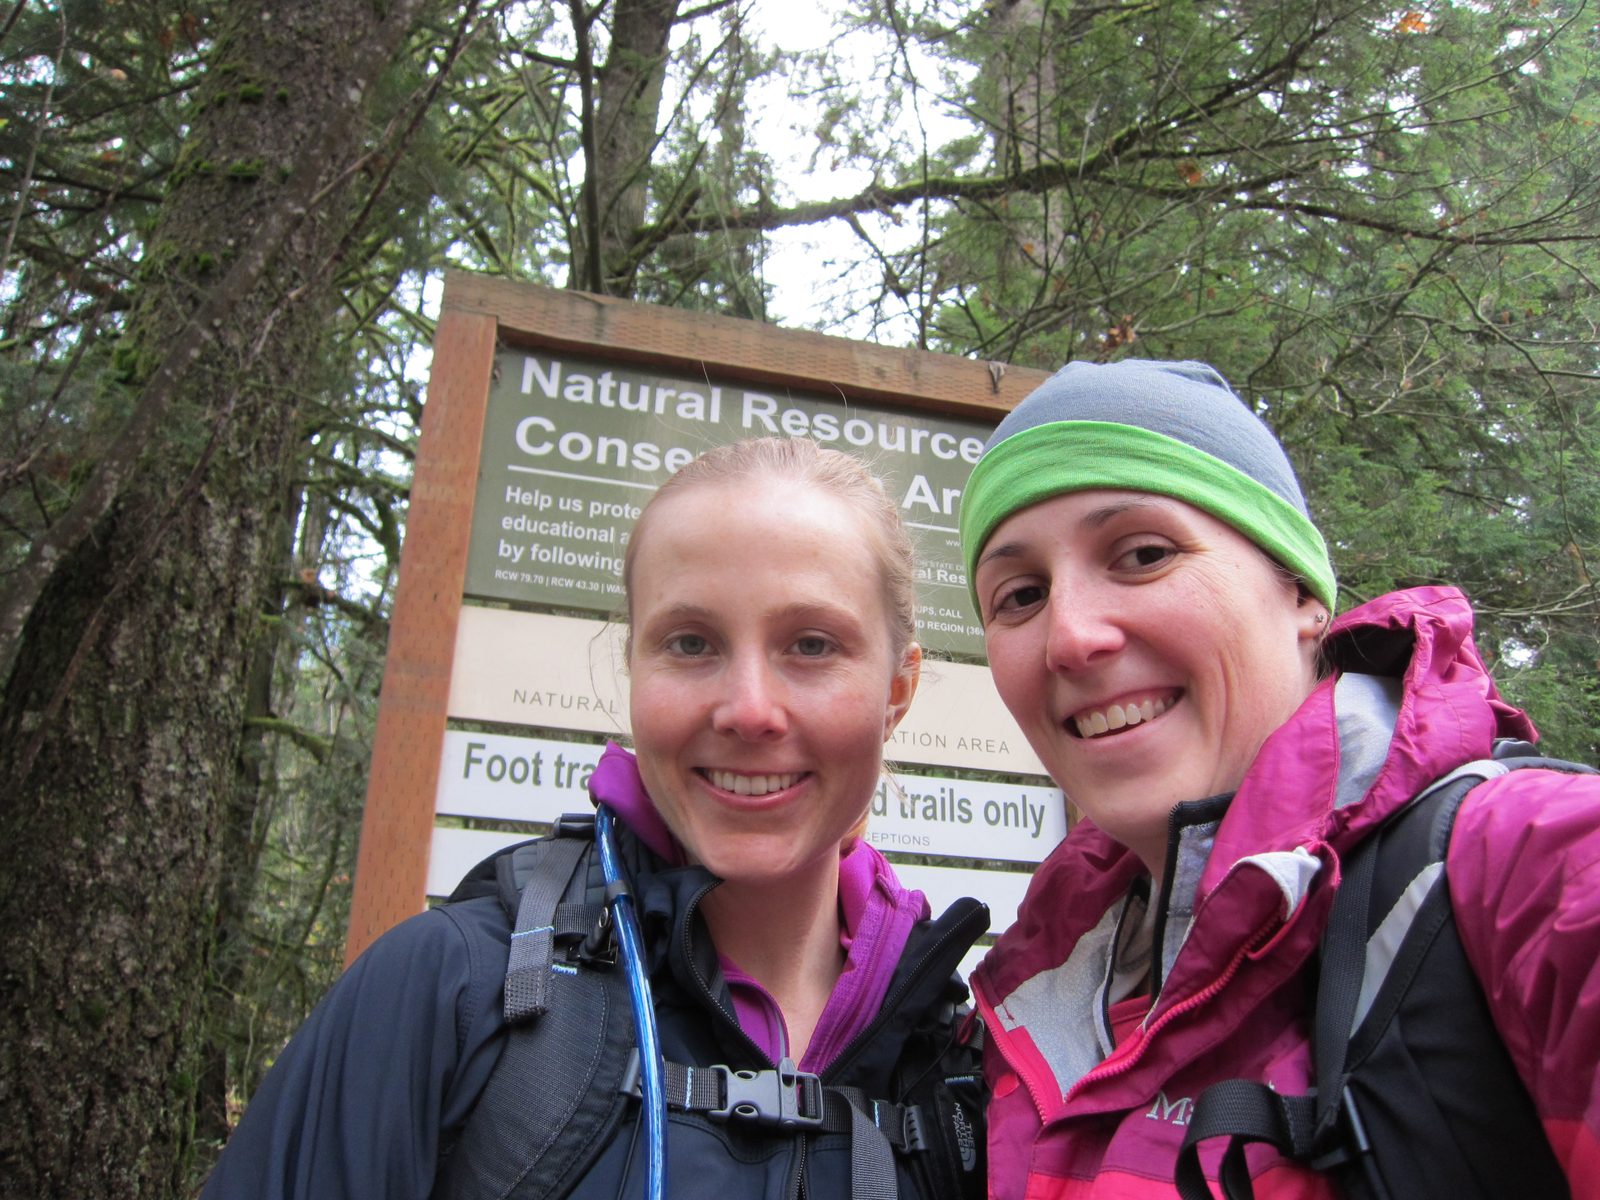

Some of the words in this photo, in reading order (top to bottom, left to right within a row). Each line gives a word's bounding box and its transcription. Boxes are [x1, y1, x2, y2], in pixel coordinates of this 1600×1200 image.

[521, 356, 722, 423] Natural
[742, 392, 983, 464] Resource
[506, 485, 552, 512] Help
[558, 494, 583, 513] us
[502, 515, 615, 544] educational
[498, 540, 525, 563] by
[530, 544, 625, 577] following
[494, 569, 518, 580] RCW
[520, 573, 544, 585] 79.70
[551, 576, 574, 588] RCW
[575, 580, 599, 592] 43.30
[927, 621, 964, 633] REGION
[939, 608, 962, 618] CALL
[513, 689, 619, 714] NATURAL
[957, 736, 1010, 755] AREA
[463, 742, 543, 786] Foot
[900, 786, 973, 824] trails
[983, 794, 1046, 839] only
[952, 1114, 965, 1147] FACE
[954, 1102, 970, 1149] NORTH
[965, 1122, 975, 1150] THE
